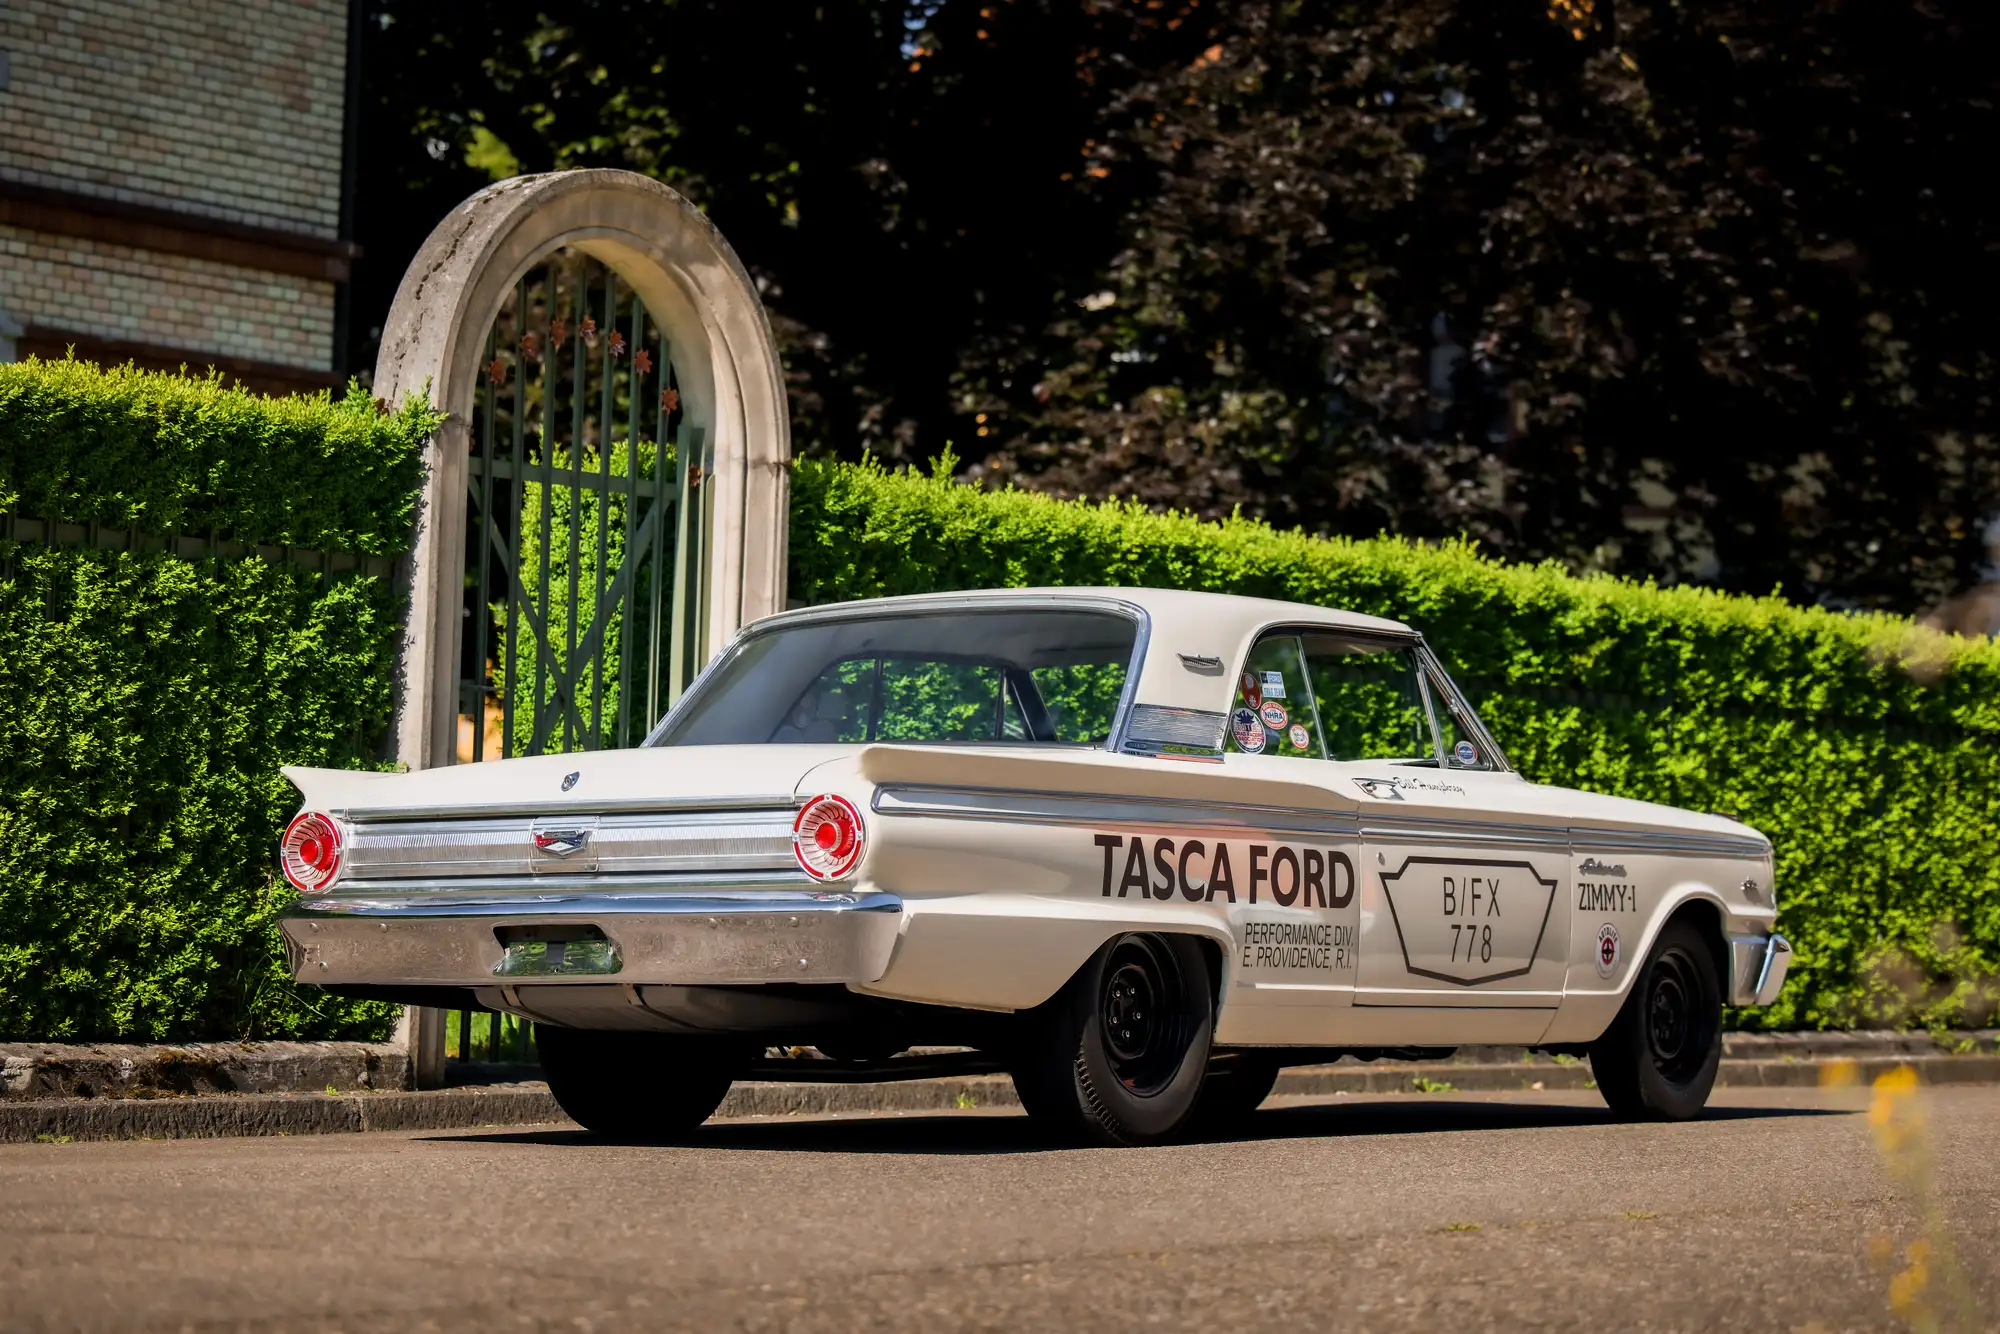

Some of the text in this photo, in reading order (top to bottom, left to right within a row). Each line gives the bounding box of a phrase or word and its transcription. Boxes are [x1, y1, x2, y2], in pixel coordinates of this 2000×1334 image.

[1265, 711, 1283, 720] NHRA
[1094, 834, 1355, 909] TASCA FORD
[1443, 876, 1501, 917] B/FX
[1245, 922, 1354, 947] PERFORMANCE DIV.
[1451, 924, 1492, 963] 778
[1242, 946, 1352, 972] E. PROVIDENCE, R.I.
